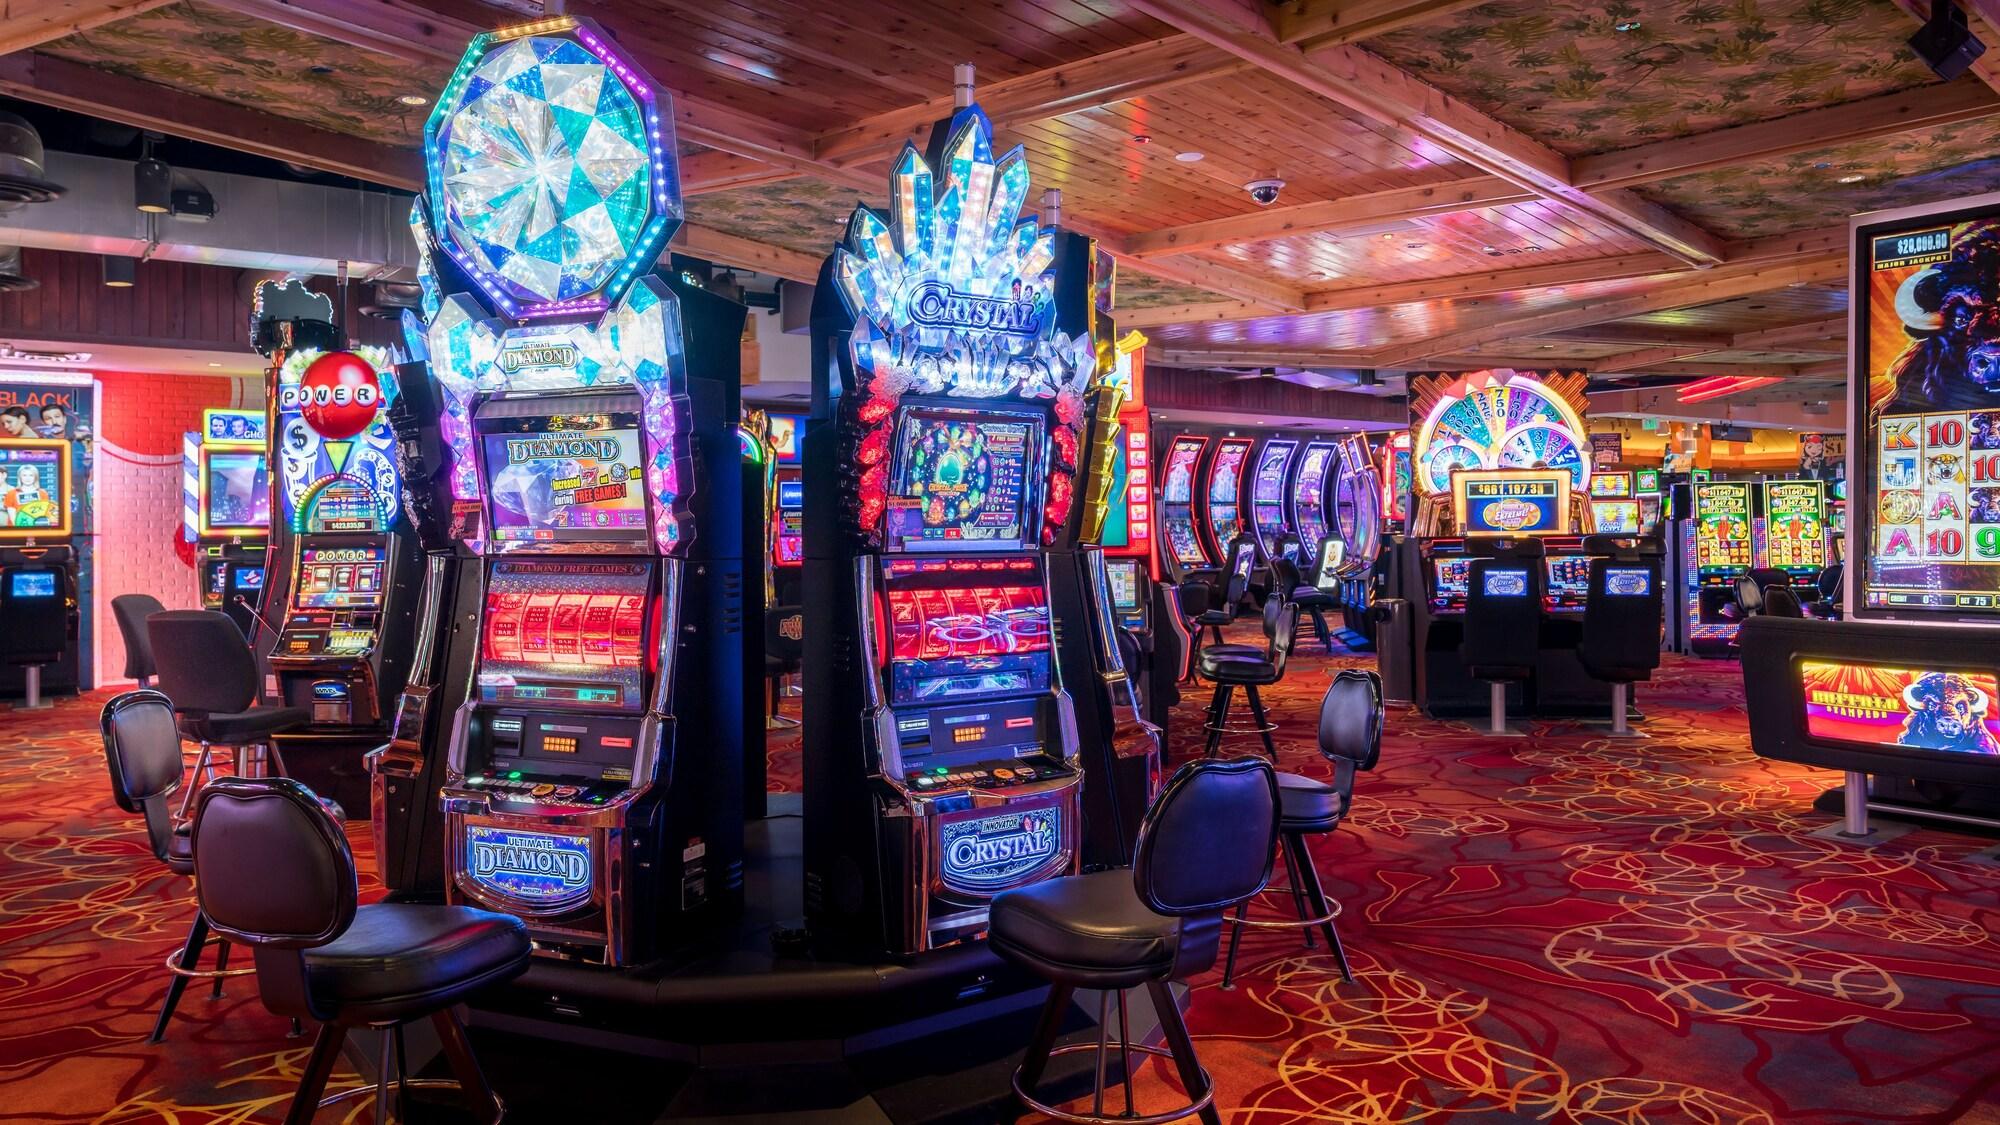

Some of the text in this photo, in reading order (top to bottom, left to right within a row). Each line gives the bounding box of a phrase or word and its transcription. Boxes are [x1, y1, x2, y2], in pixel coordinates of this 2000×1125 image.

[1898, 233, 1947, 254] $20,000.00
[1877, 255, 1947, 269] MAJOR JACKPOT
[908, 282, 1040, 333] CRYSTAL
[505, 348, 575, 371] DIAMOND
[0, 390, 72, 409] BLACK
[284, 387, 370, 404] POWER
[1509, 391, 1520, 418] 150
[1462, 400, 1481, 425] 100
[244, 430, 266, 439] GHO
[1884, 420, 1964, 450] K 10
[509, 439, 620, 464] DIAMOND
[1885, 457, 1916, 487] J
[554, 495, 573, 506] during
[575, 488, 594, 504] FREE
[1926, 492, 1962, 520] A
[1882, 526, 2000, 558] A 10 9
[317, 551, 365, 559] POWER
[514, 564, 627, 573] DIAMOND FREE GAMES
[1923, 594, 1929, 604] 0
[1960, 596, 1987, 606] BET 75
[983, 820, 1018, 831] INNOVATOR
[507, 837, 553, 849] ULTIMATE
[948, 831, 1053, 870] CRYSTAL
[477, 844, 589, 883] DIAMOND
